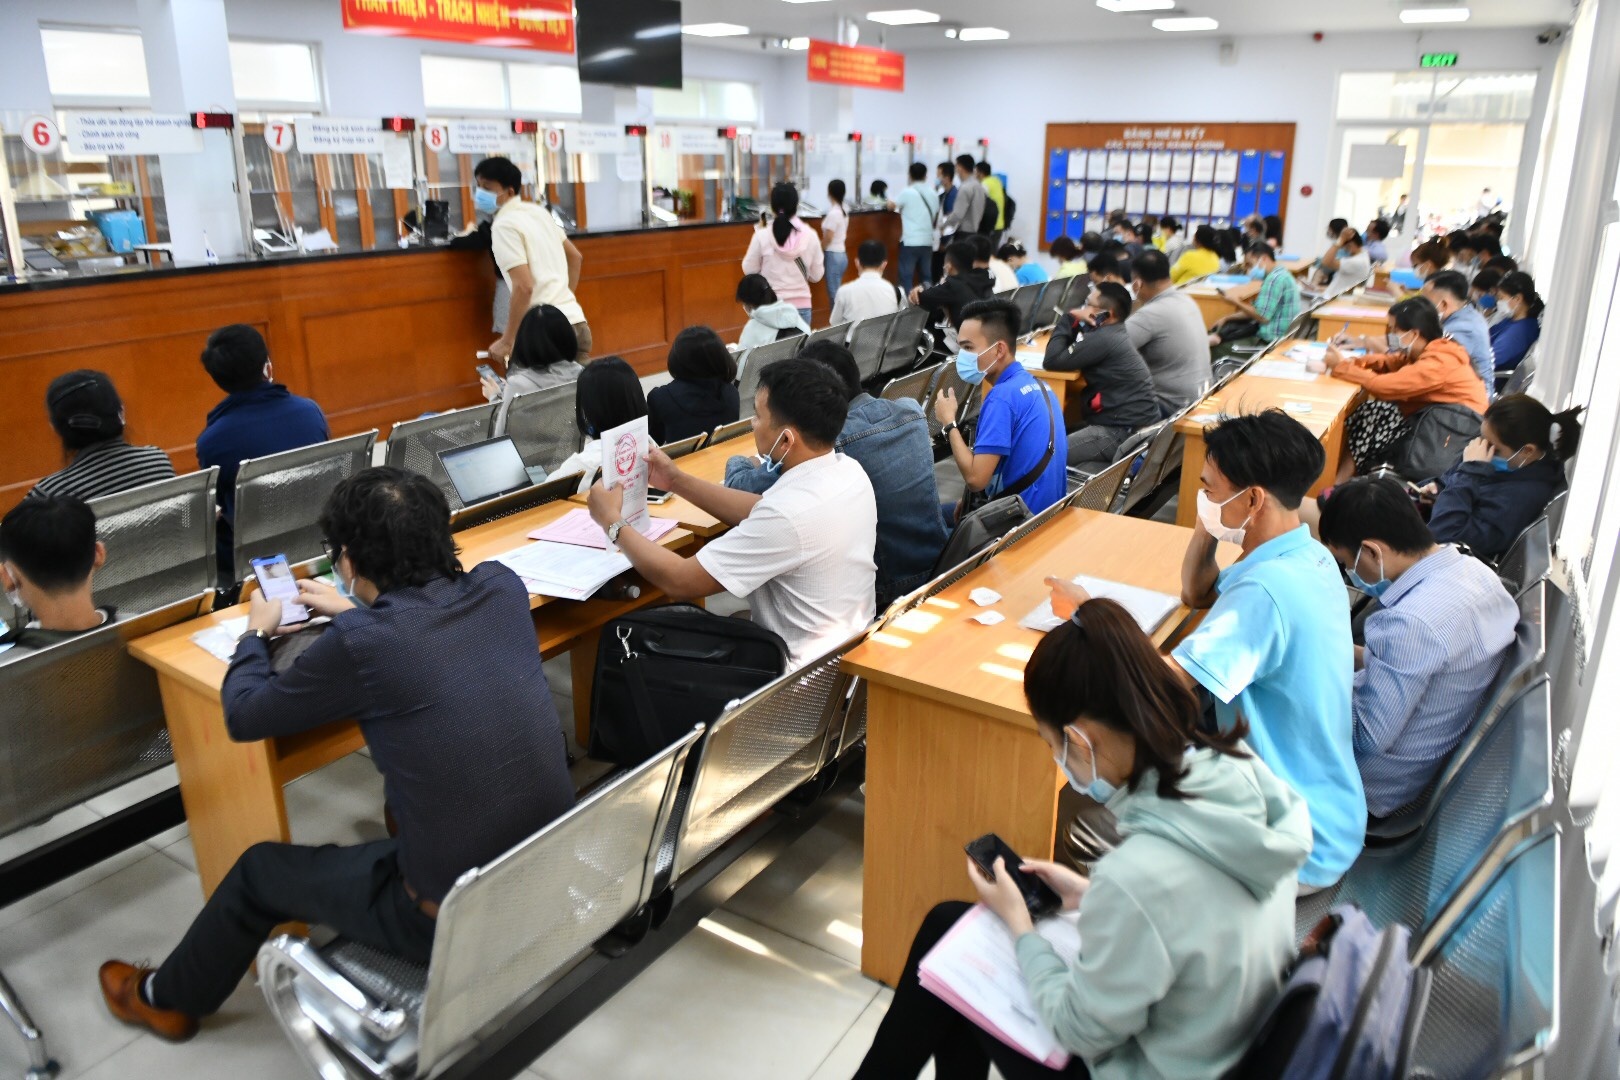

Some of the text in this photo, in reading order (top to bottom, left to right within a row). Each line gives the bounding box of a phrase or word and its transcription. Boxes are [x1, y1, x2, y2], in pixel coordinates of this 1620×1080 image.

[33, 121, 51, 146] 6
[272, 126, 284, 146] 7
[431, 128, 441, 147] 8
[549, 132, 558, 148] 9
[1123, 126, 1153, 140] BẢNG
[1184, 125, 1206, 140] YẾT
